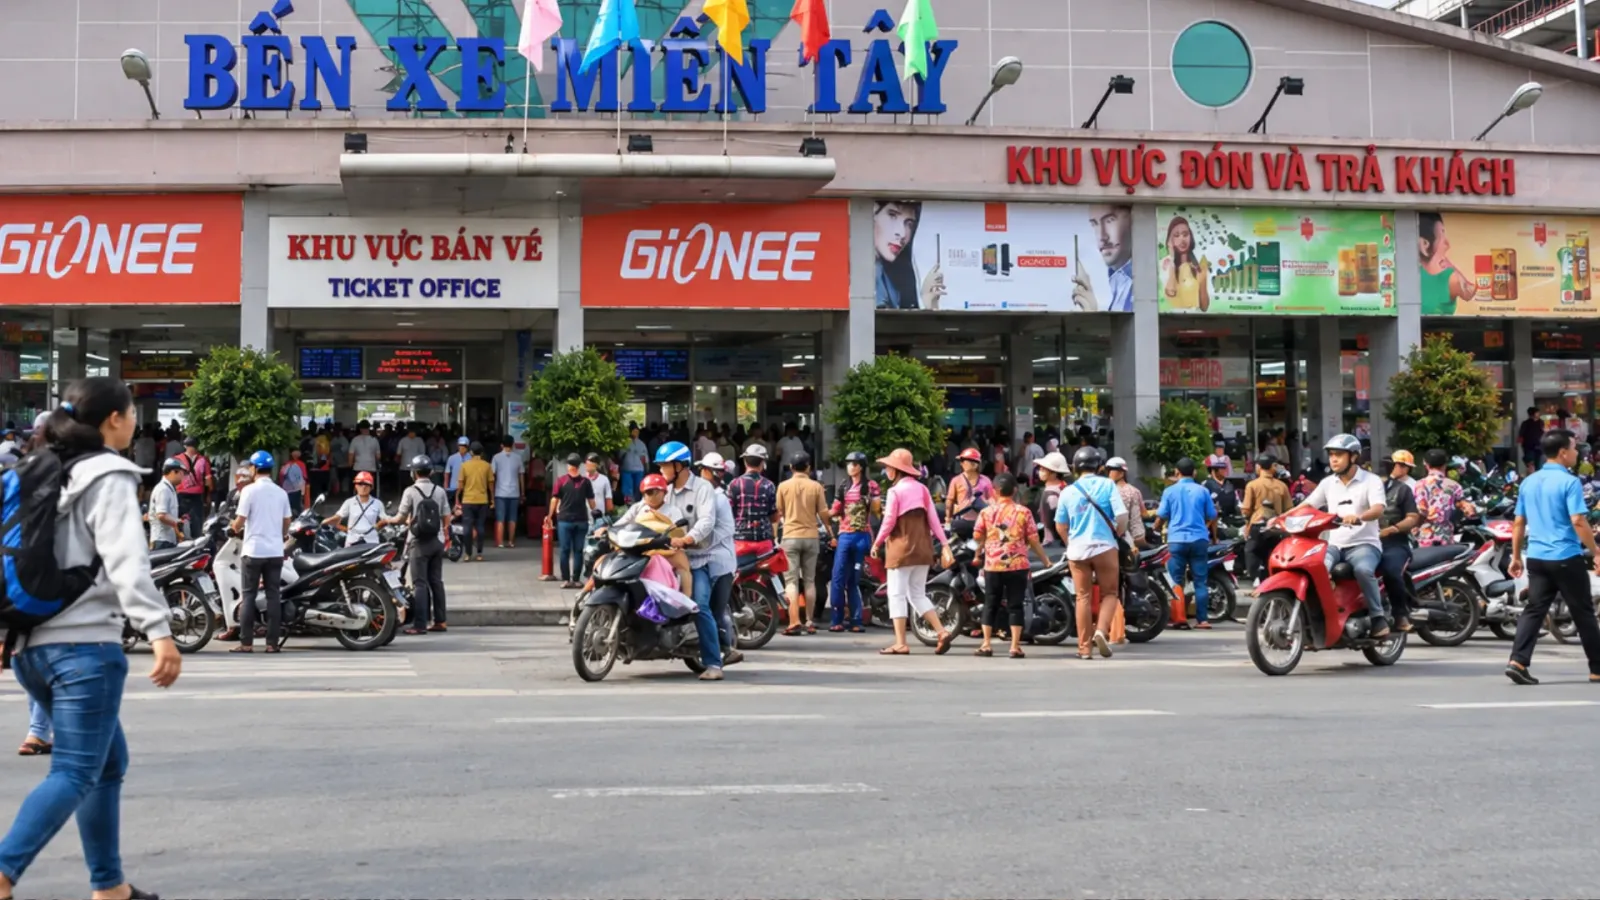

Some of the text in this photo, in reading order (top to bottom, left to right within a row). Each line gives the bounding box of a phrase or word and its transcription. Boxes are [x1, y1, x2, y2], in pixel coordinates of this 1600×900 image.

[184, 0, 356, 111] BẾN
[386, 36, 508, 112] XE
[798, 9, 958, 114] TÂY
[1007, 141, 1516, 196] KHU VỰC ĐÓN VÀ TRẢ KHÁCH
[287, 226, 543, 268] KHU VỰC BÁN VÉ
[328, 277, 501, 299] TICKET OFFICE
